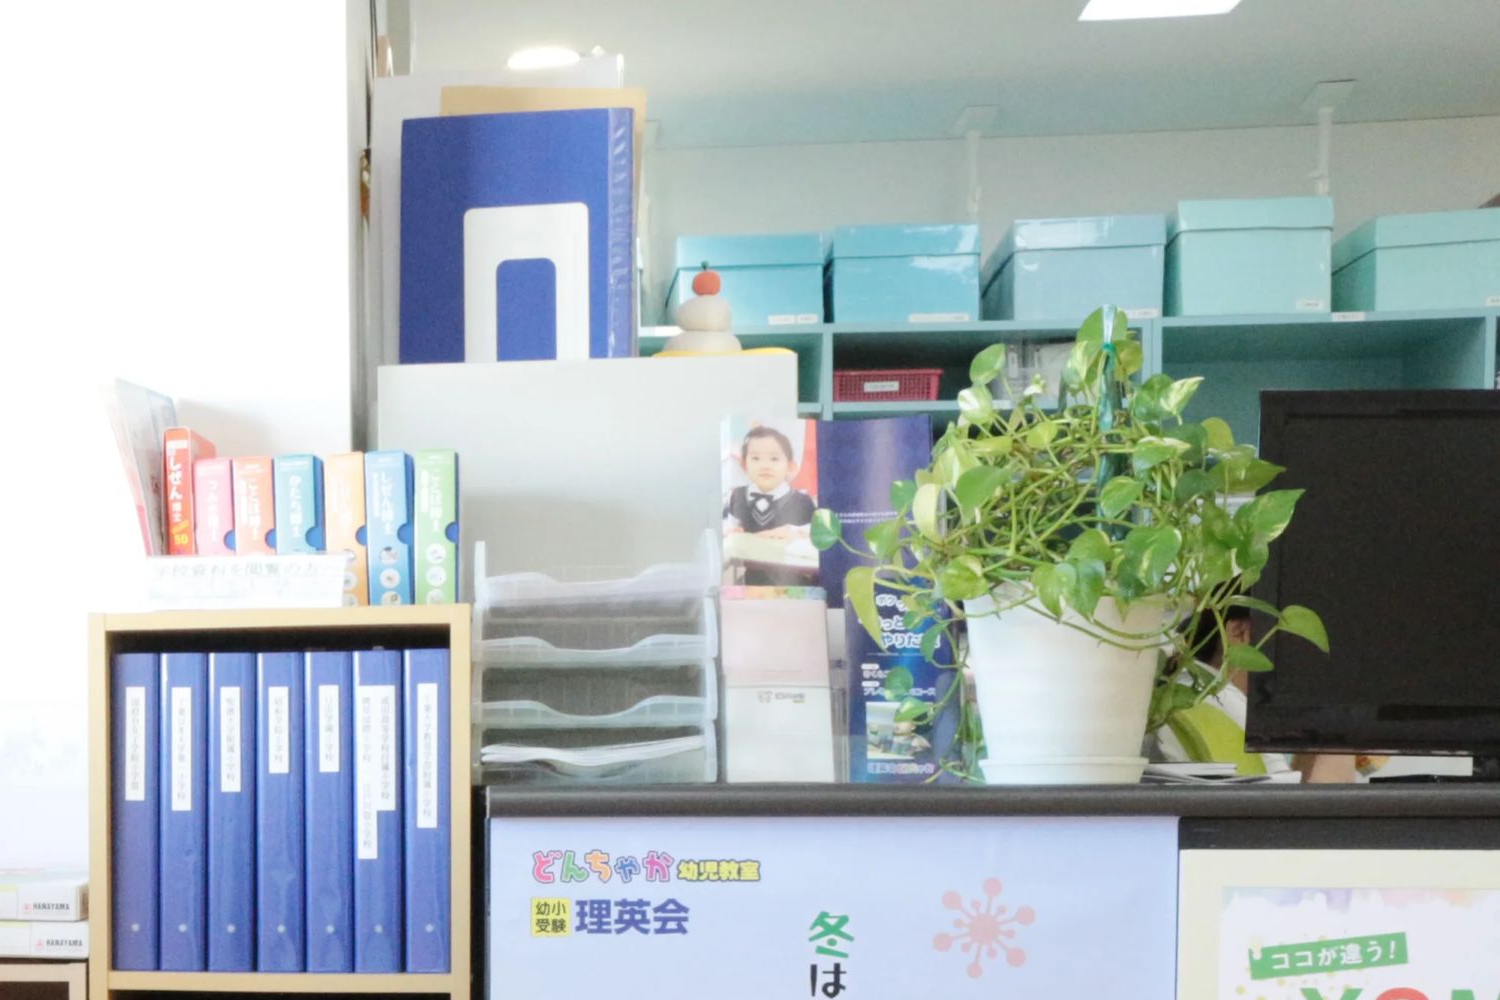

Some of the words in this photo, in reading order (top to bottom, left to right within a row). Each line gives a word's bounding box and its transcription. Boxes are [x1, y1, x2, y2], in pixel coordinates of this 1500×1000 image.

[532, 849, 675, 884] どんちゃか
[677, 858, 761, 882] 幼児教室
[535, 902, 567, 915] 幼小
[575, 898, 690, 935] 理英会
[535, 918, 567, 934] 受験
